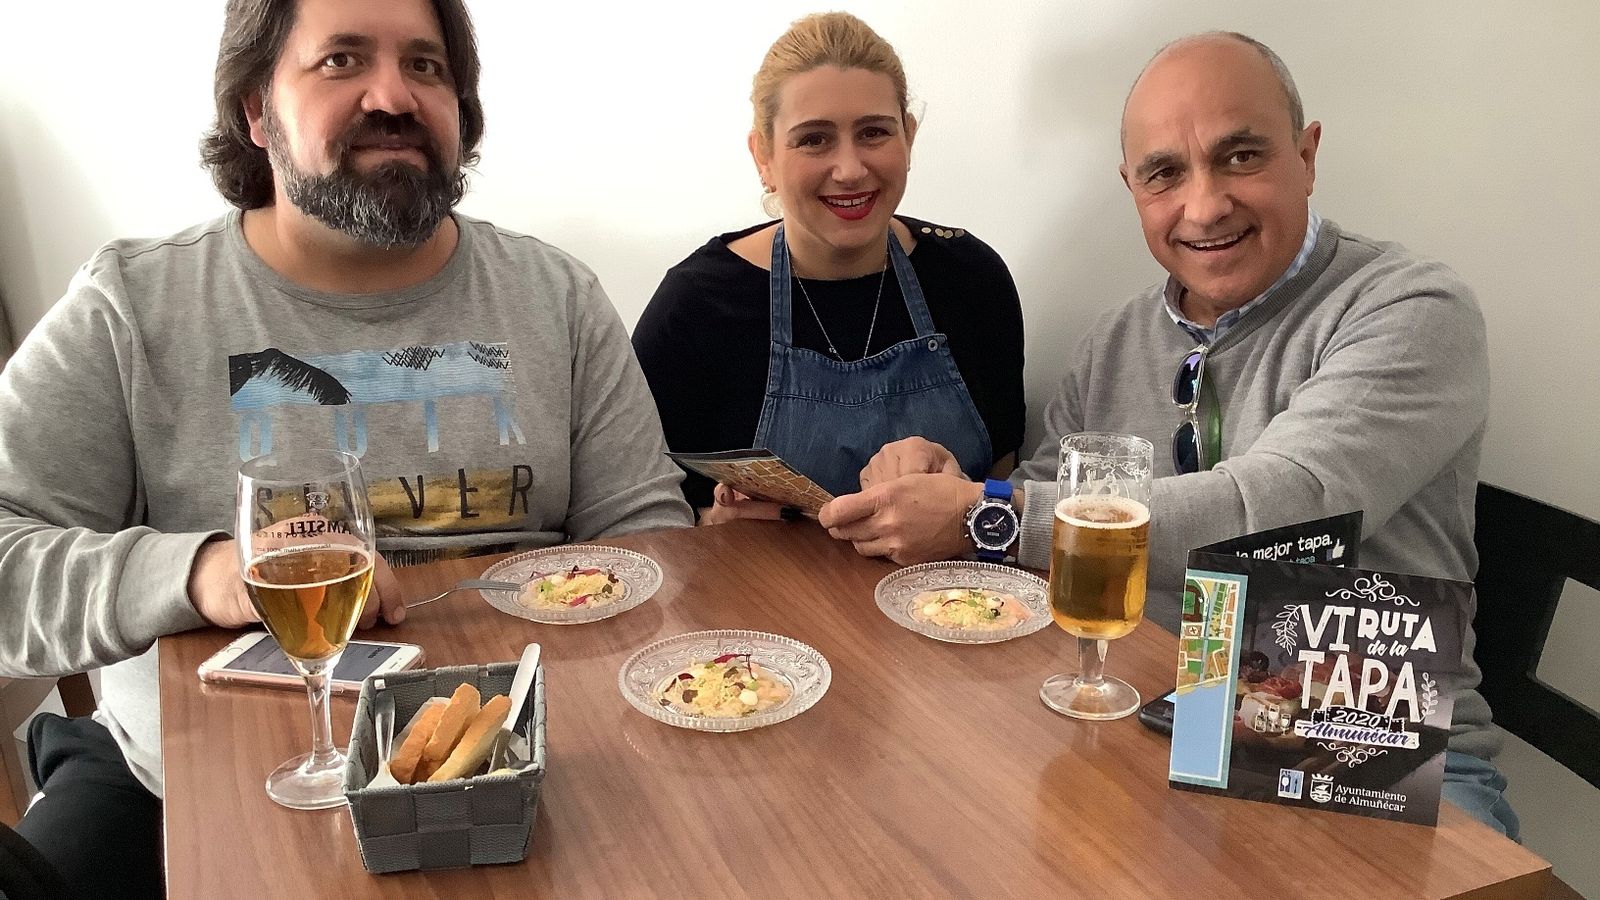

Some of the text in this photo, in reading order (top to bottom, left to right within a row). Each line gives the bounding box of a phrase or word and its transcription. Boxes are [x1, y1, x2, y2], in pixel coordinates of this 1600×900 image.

[1252, 533, 1333, 561] mejor tapa.
[1300, 604, 1437, 653] VI RUTA
[1366, 639, 1409, 657] de la
[1298, 649, 1421, 723] TAPA
[1332, 709, 1382, 729] 2020
[1335, 784, 1407, 803] Ayuntamiento
[1334, 795, 1406, 813] de Almuñécar
